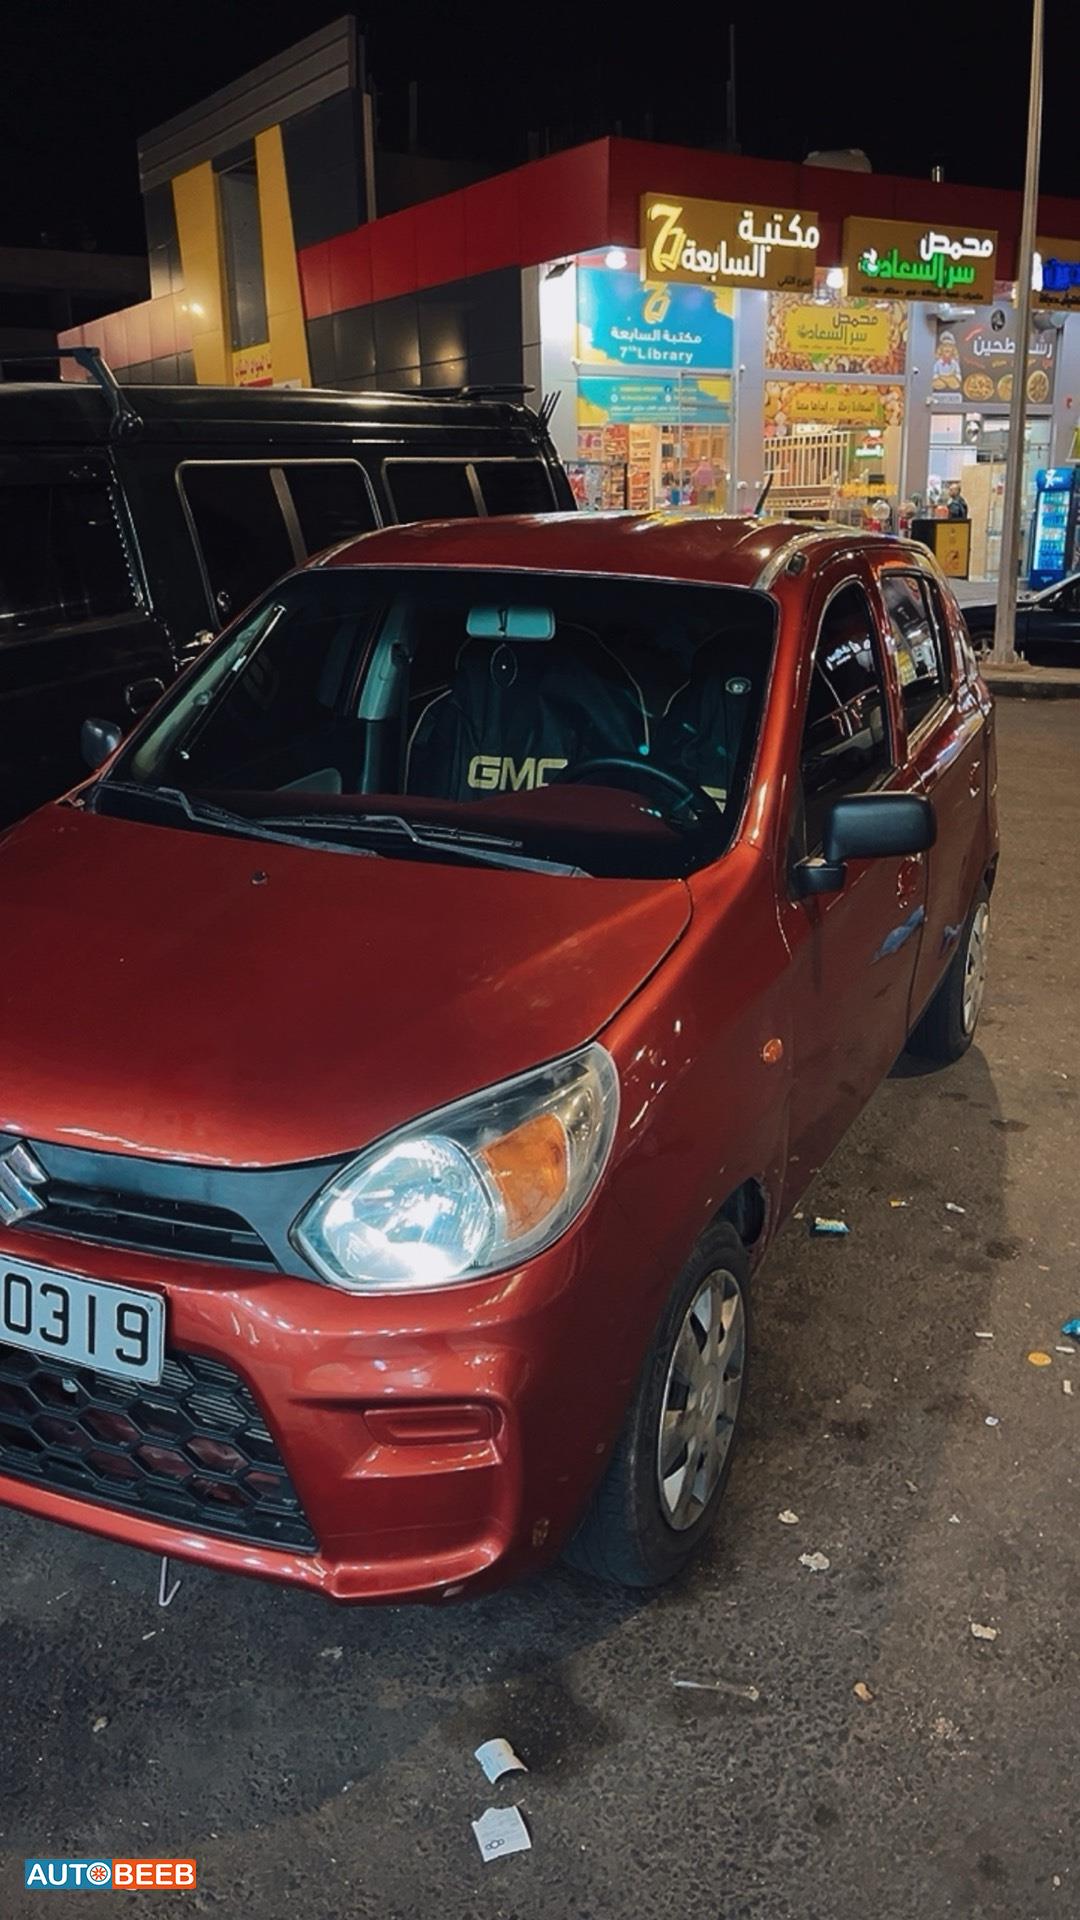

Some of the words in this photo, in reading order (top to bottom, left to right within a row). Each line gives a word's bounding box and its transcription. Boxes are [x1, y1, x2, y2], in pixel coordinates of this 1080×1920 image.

[738, 210, 820, 249] مكتبة
[920, 231, 994, 260] محمص
[681, 239, 766, 281] السابعة
[945, 265, 975, 288] سر
[832, 312, 879, 328] محمص
[611, 326, 661, 342] السابعة
[663, 329, 702, 344] مكتبة
[849, 332, 867, 346] سر
[638, 348, 693, 364] Library
[973, 336, 1016, 356] طحين
[467, 755, 568, 791] GMC
[4, 1272, 149, 1367] 0319
